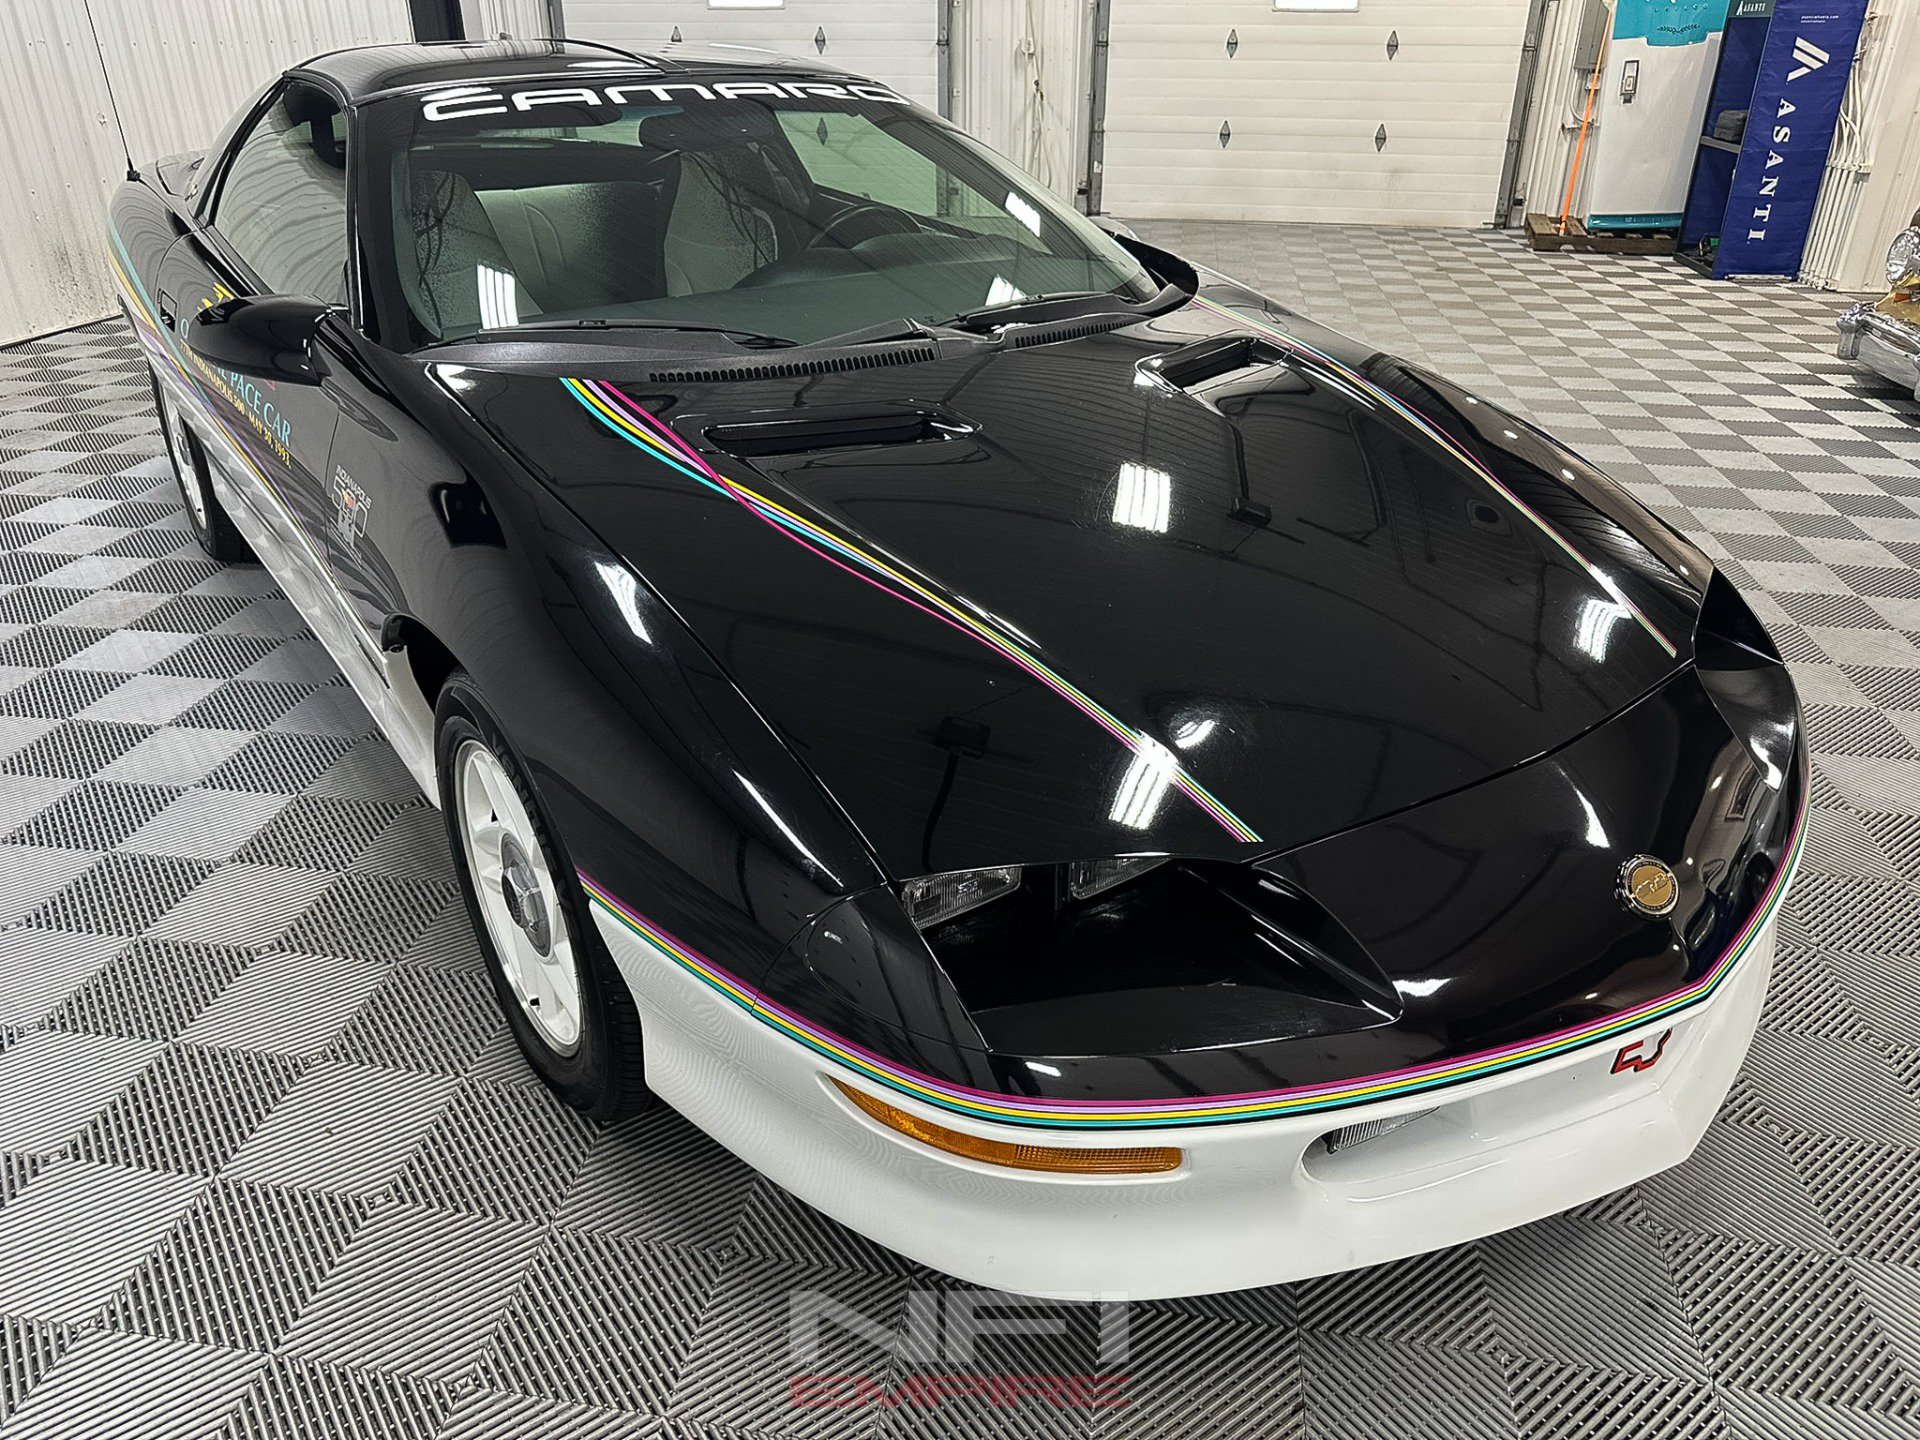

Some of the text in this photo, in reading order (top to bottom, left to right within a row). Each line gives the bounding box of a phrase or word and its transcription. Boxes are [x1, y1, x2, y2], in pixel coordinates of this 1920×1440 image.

[420, 83, 910, 122] CAMARO
[1747, 98, 1797, 242] ASANTI
[229, 371, 291, 448] PACE CAR
